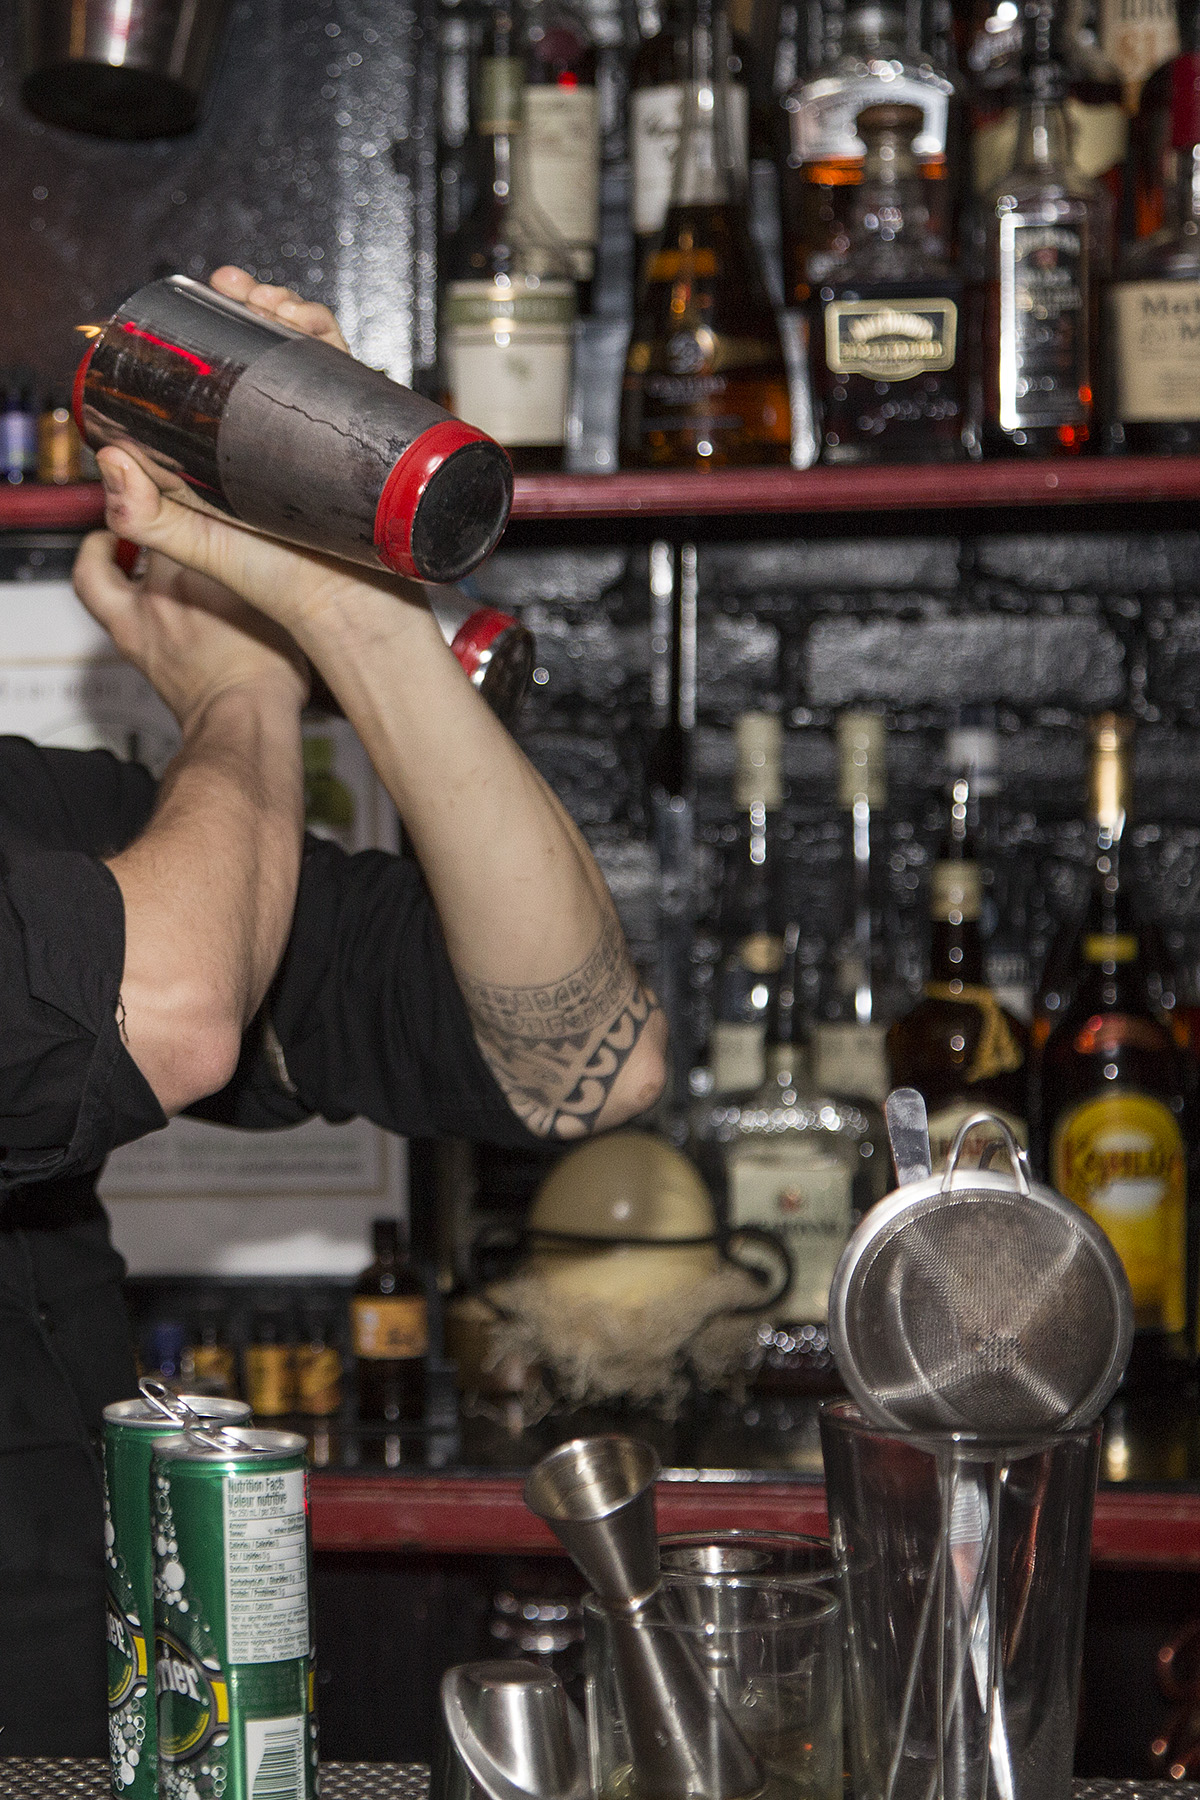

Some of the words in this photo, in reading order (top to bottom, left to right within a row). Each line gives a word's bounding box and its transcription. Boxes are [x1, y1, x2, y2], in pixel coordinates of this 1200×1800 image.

[228, 1479, 264, 1493] Nutrition
[266, 1477, 285, 1491] Facts
[228, 1494, 255, 1508] Valeur
[257, 1491, 287, 1507] nutritive
